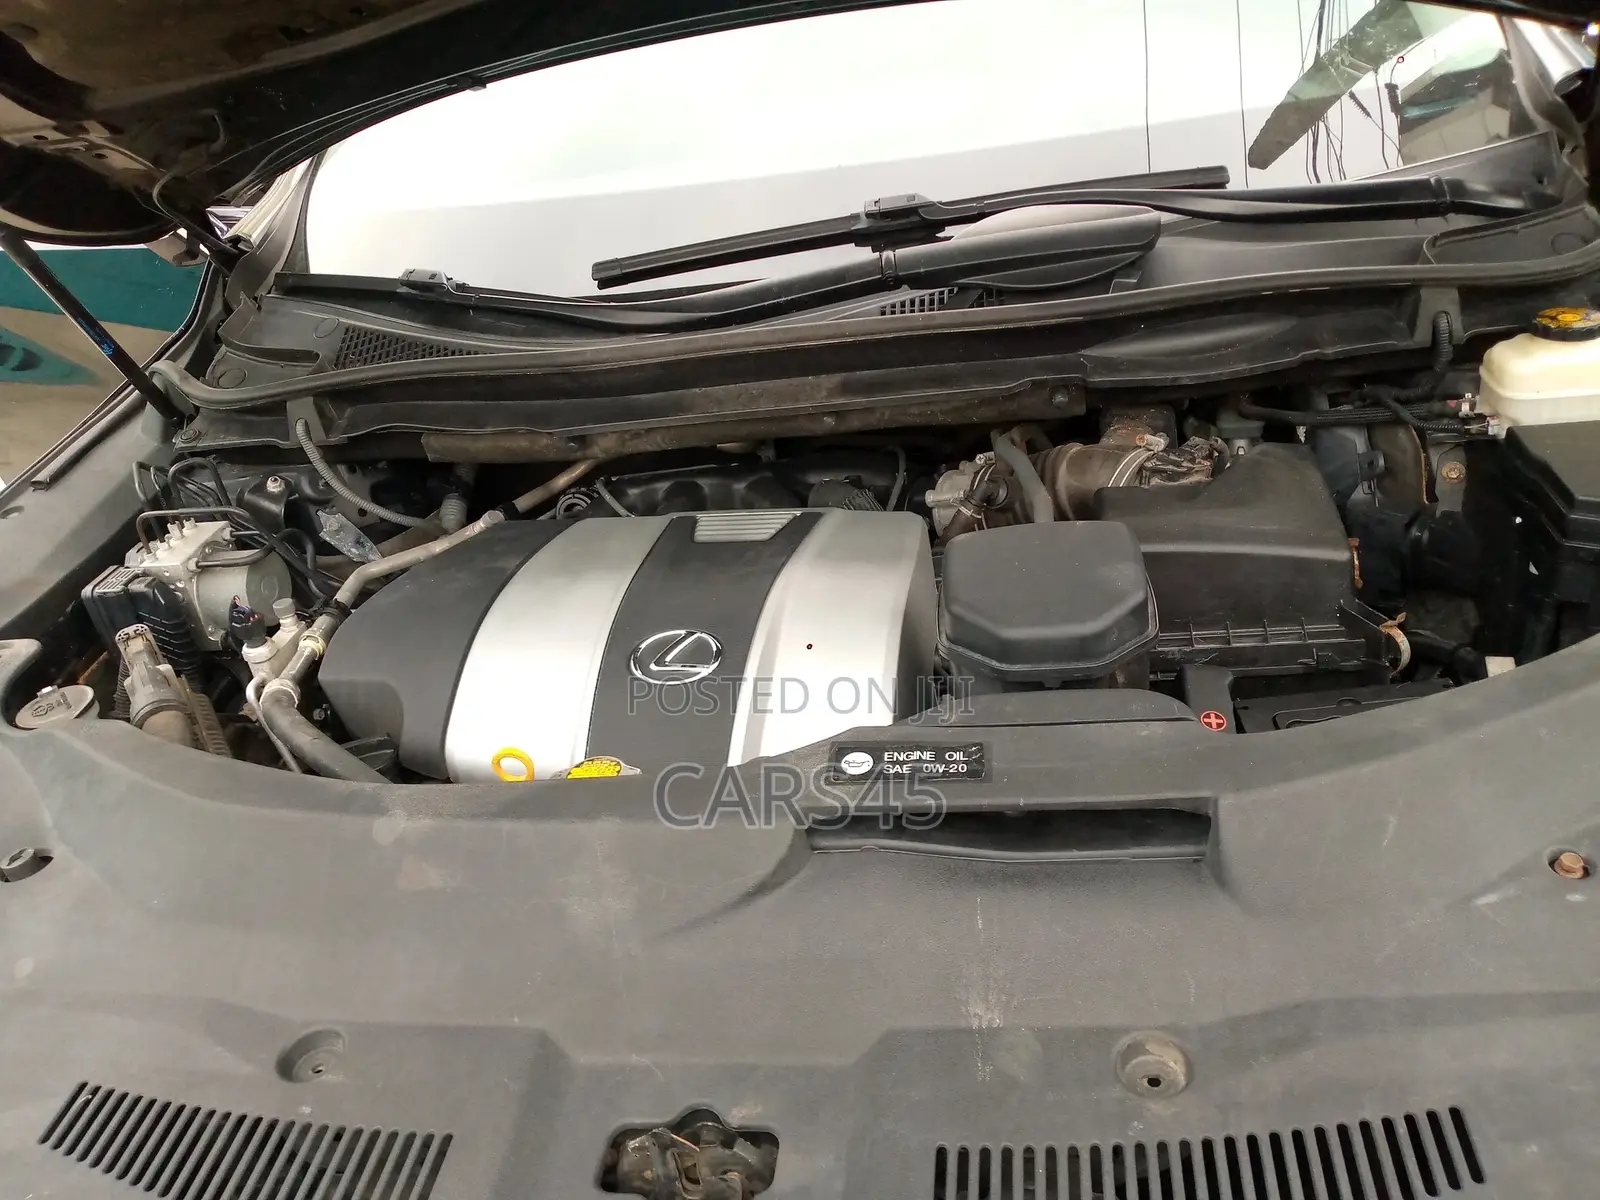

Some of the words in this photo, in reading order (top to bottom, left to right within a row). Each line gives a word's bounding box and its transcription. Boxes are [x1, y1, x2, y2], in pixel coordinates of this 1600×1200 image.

[883, 751, 936, 761] ENGINE
[945, 751, 969, 761] OIL
[883, 764, 911, 774] SAE
[922, 763, 968, 773] 0W-20
